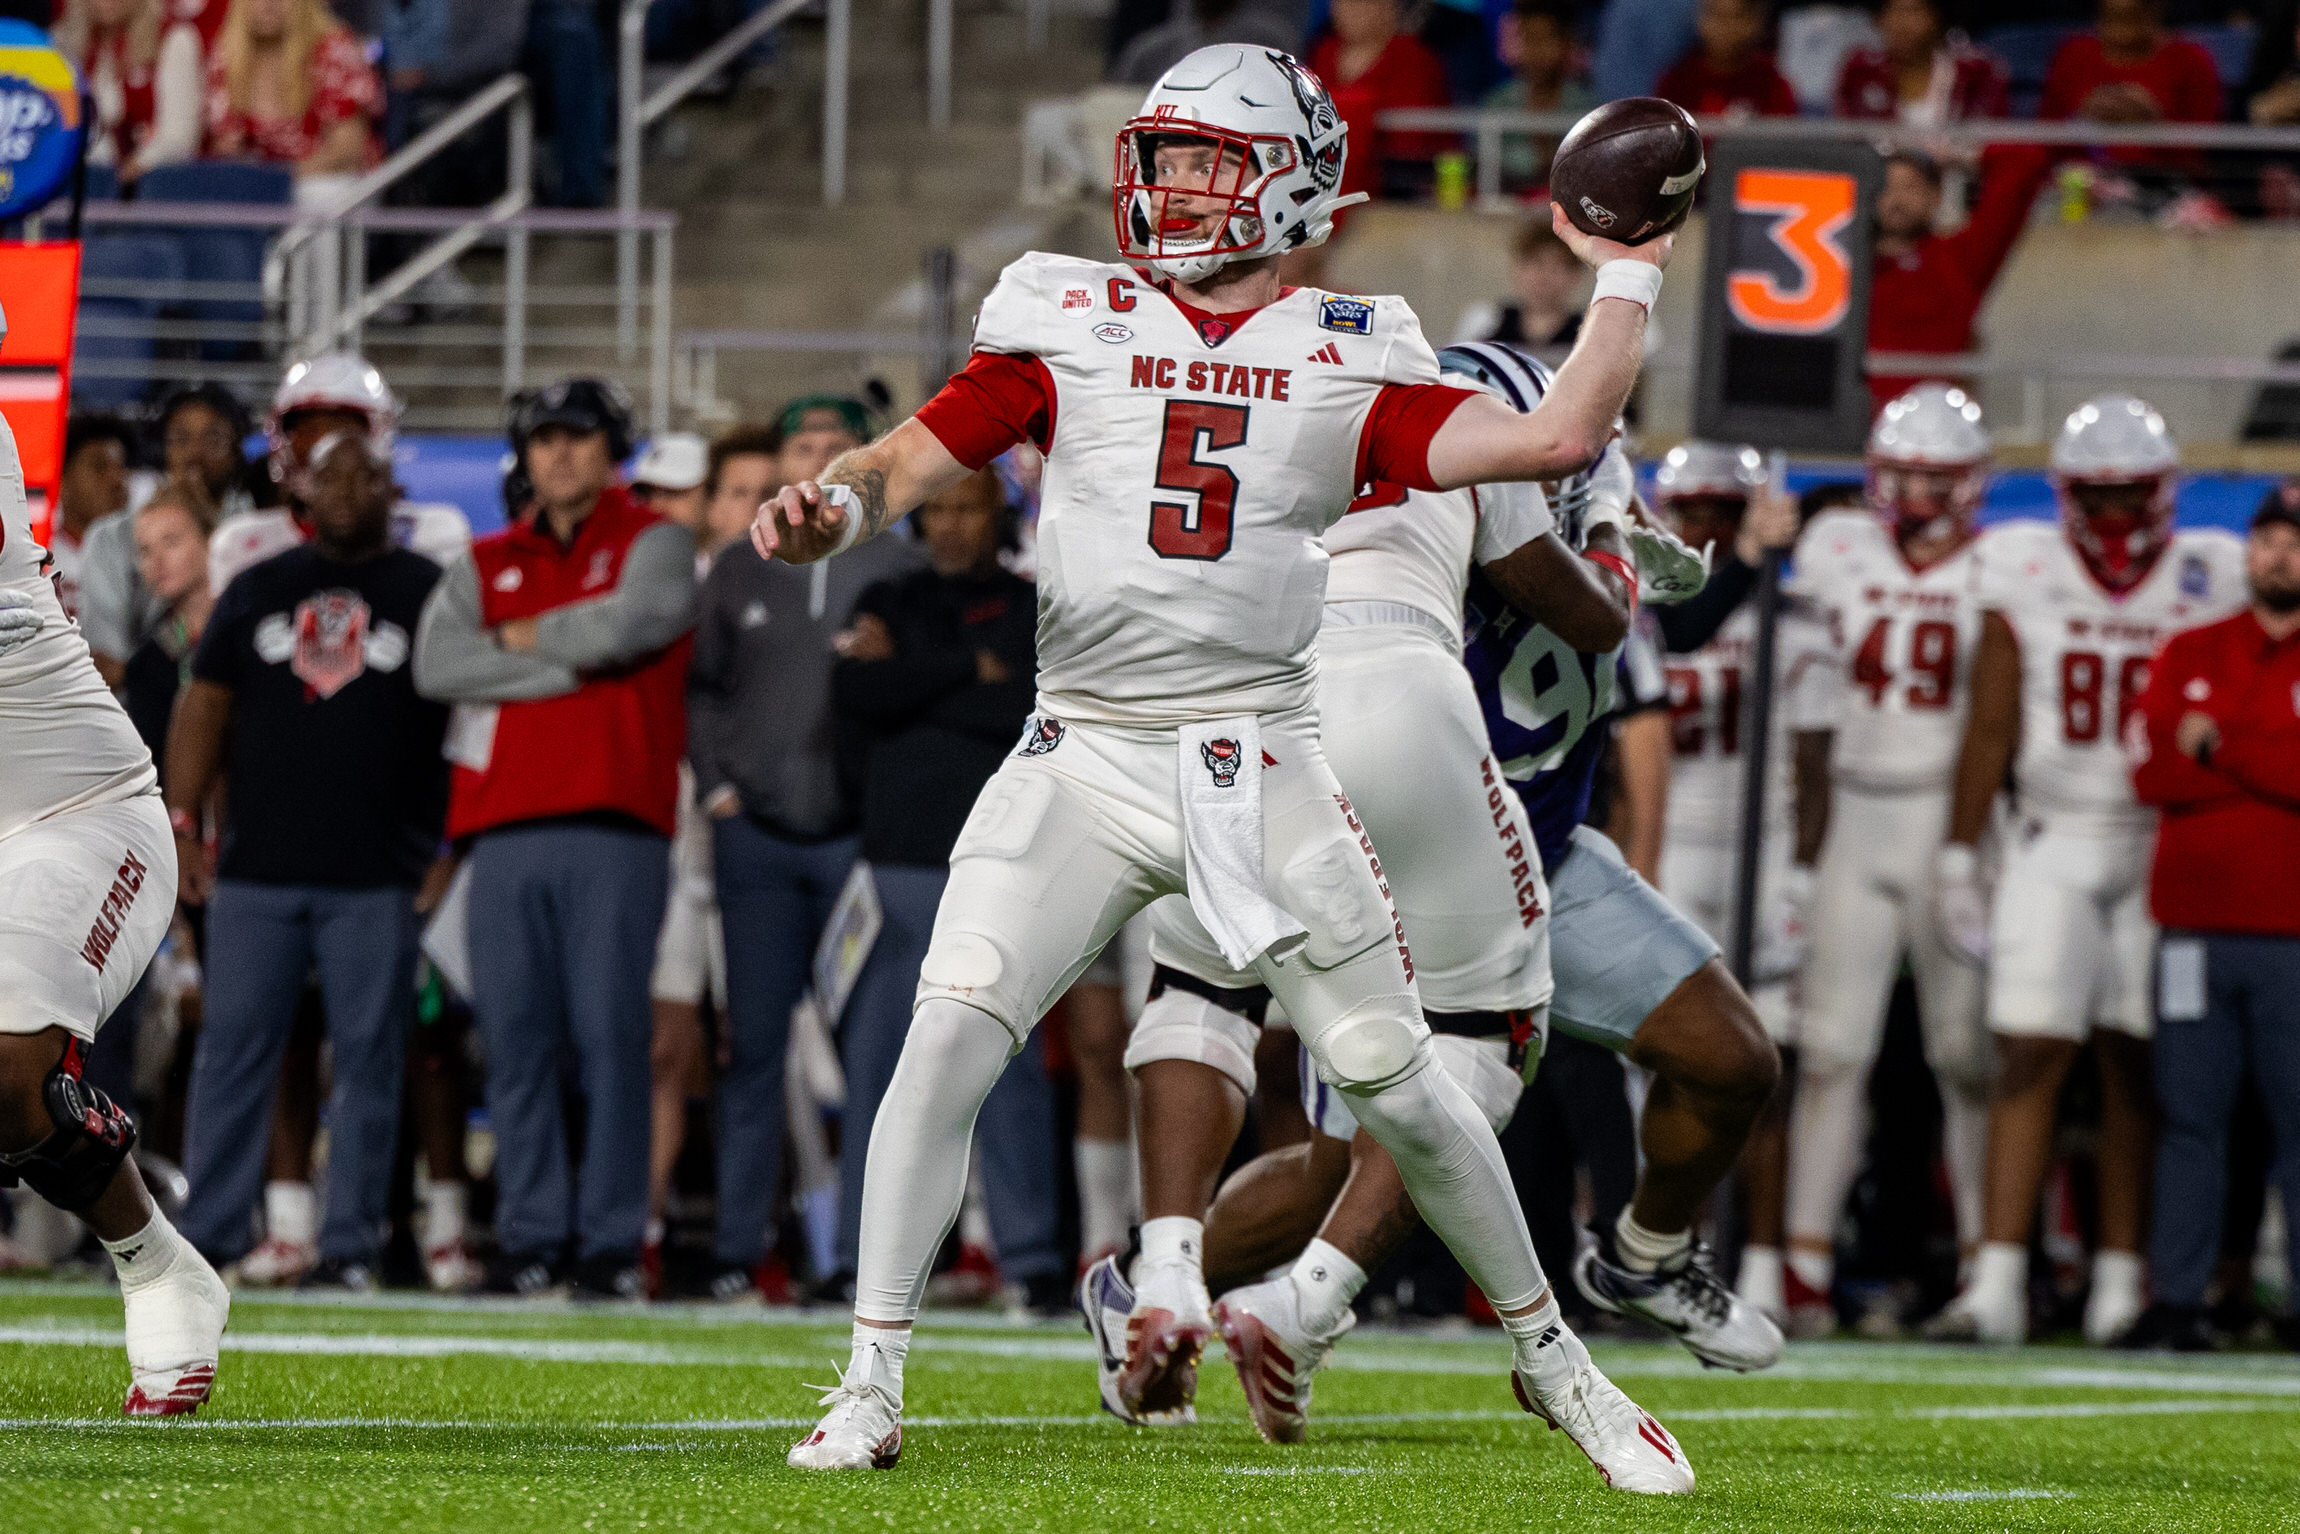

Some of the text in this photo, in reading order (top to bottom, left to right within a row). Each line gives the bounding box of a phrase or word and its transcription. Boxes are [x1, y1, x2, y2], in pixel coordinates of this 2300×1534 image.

[1728, 168, 1858, 334] 3
[1062, 298, 1092, 309] UNITED
[1065, 289, 1088, 300] PACK
[1107, 277, 1137, 313] C
[1099, 327, 1128, 337] ACC
[1130, 354, 1293, 402] NC STATE
[1147, 399, 1251, 562] 5
[1853, 616, 1957, 711] 49
[1480, 755, 1545, 929] WOLFPACK
[80, 848, 148, 977] WOLFPACK
